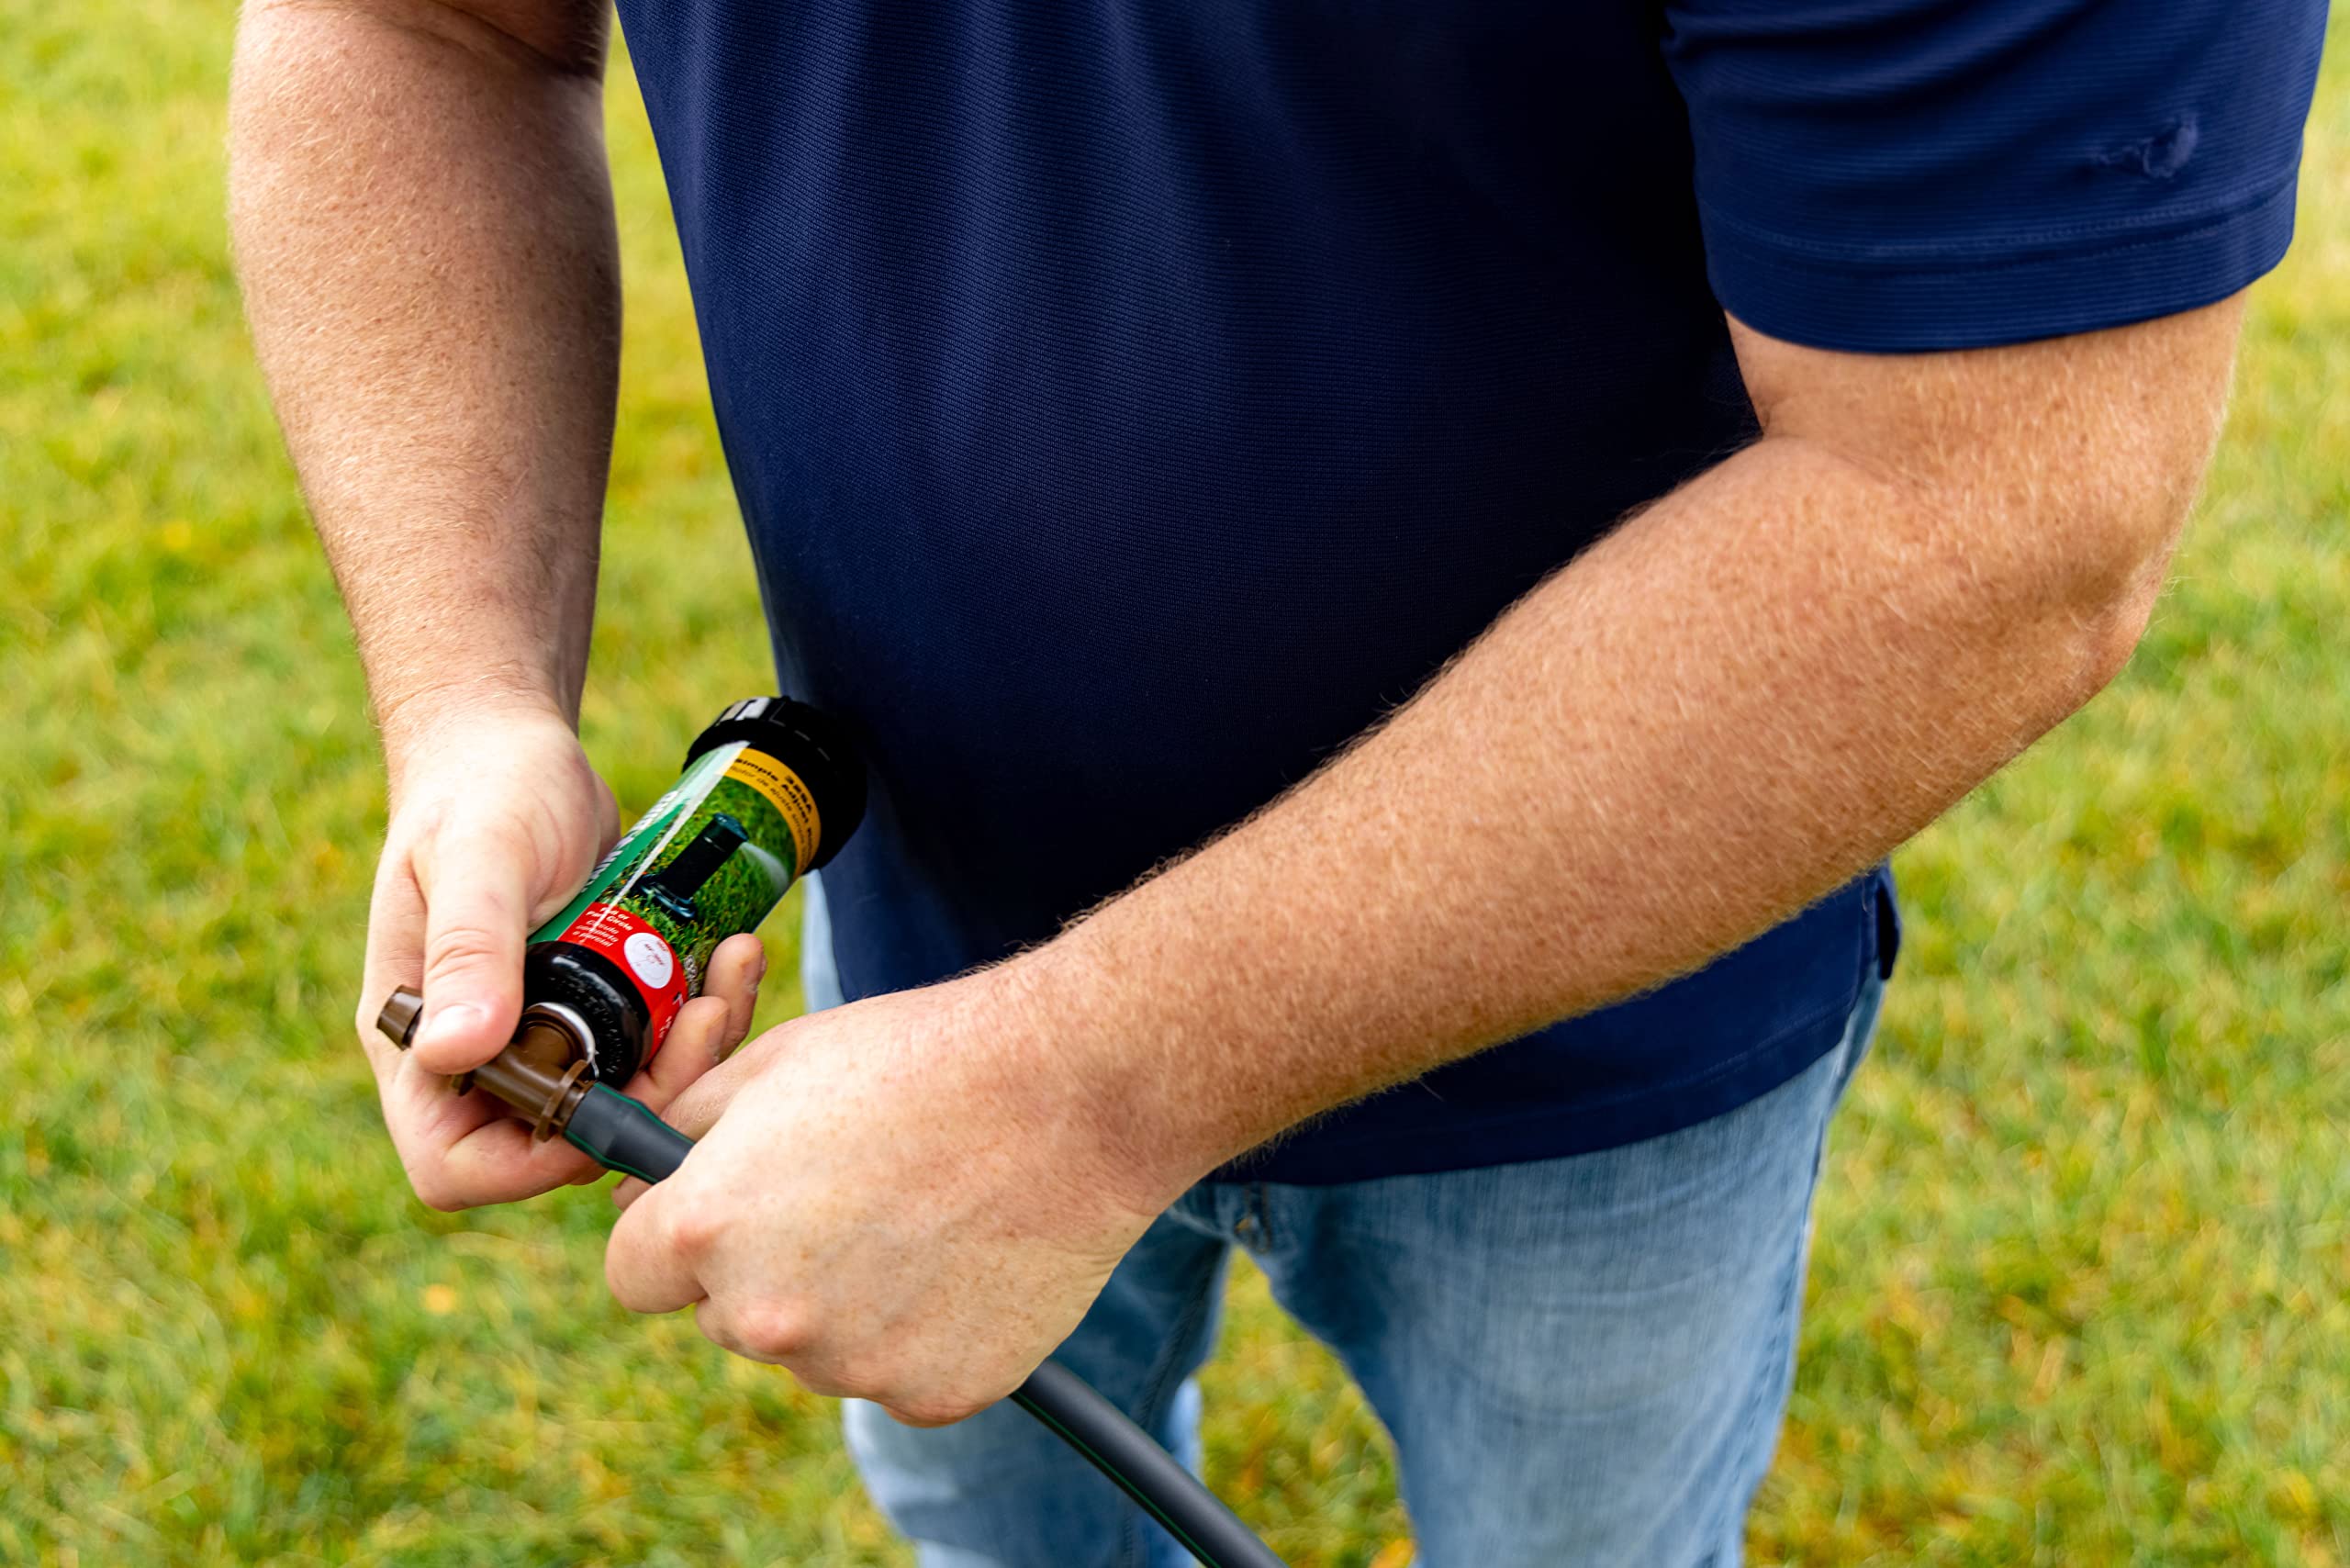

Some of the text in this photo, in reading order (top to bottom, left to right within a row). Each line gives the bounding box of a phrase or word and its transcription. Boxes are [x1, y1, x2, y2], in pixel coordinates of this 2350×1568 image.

[586, 910, 633, 931] Par Circle
[586, 919, 620, 935] Crculo
